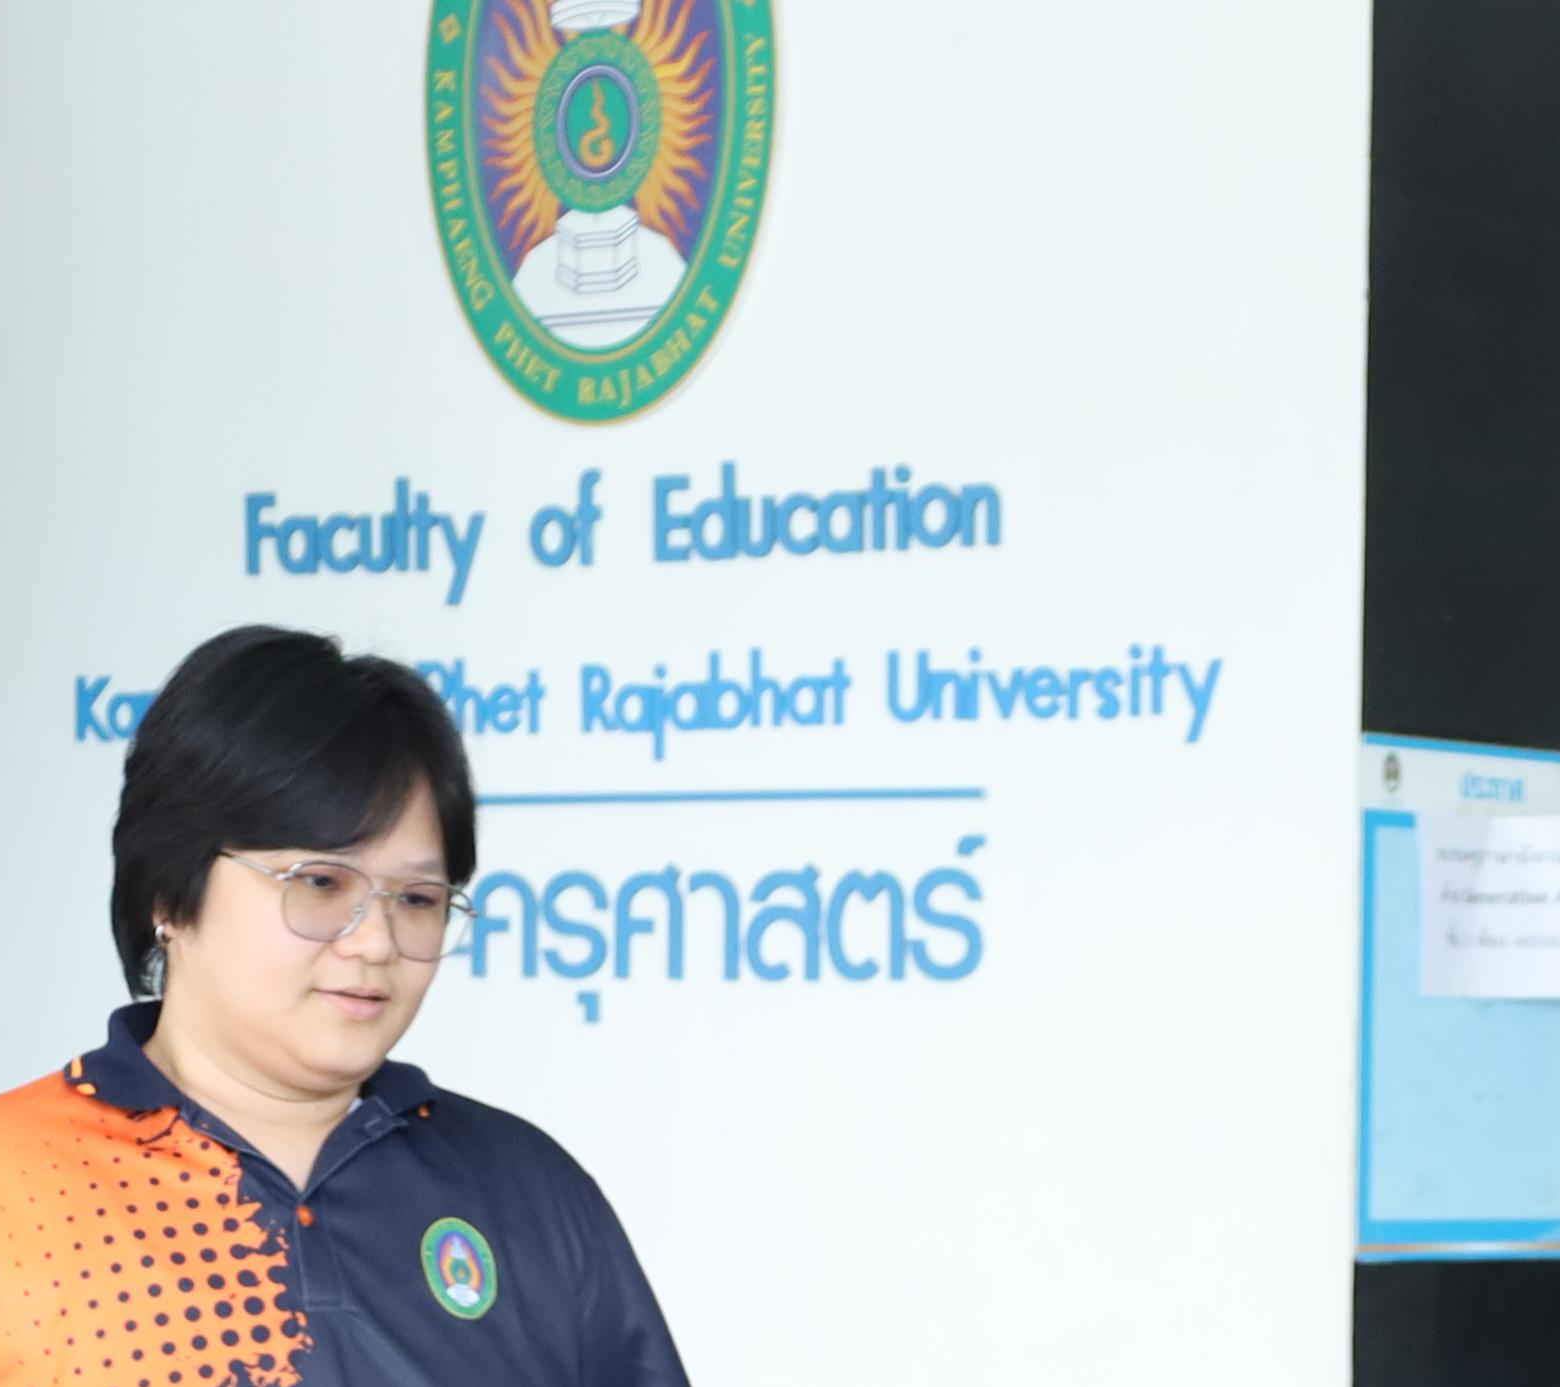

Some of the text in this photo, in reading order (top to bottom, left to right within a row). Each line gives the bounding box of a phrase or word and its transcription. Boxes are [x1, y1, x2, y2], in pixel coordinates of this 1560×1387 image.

[717, 32, 768, 269] UNIVERSITY
[244, 461, 1002, 606] Faculty of Education
[578, 646, 853, 762] Rajabhat
[886, 643, 1224, 745] University
[470, 833, 987, 1024] ครุศาสตร์
